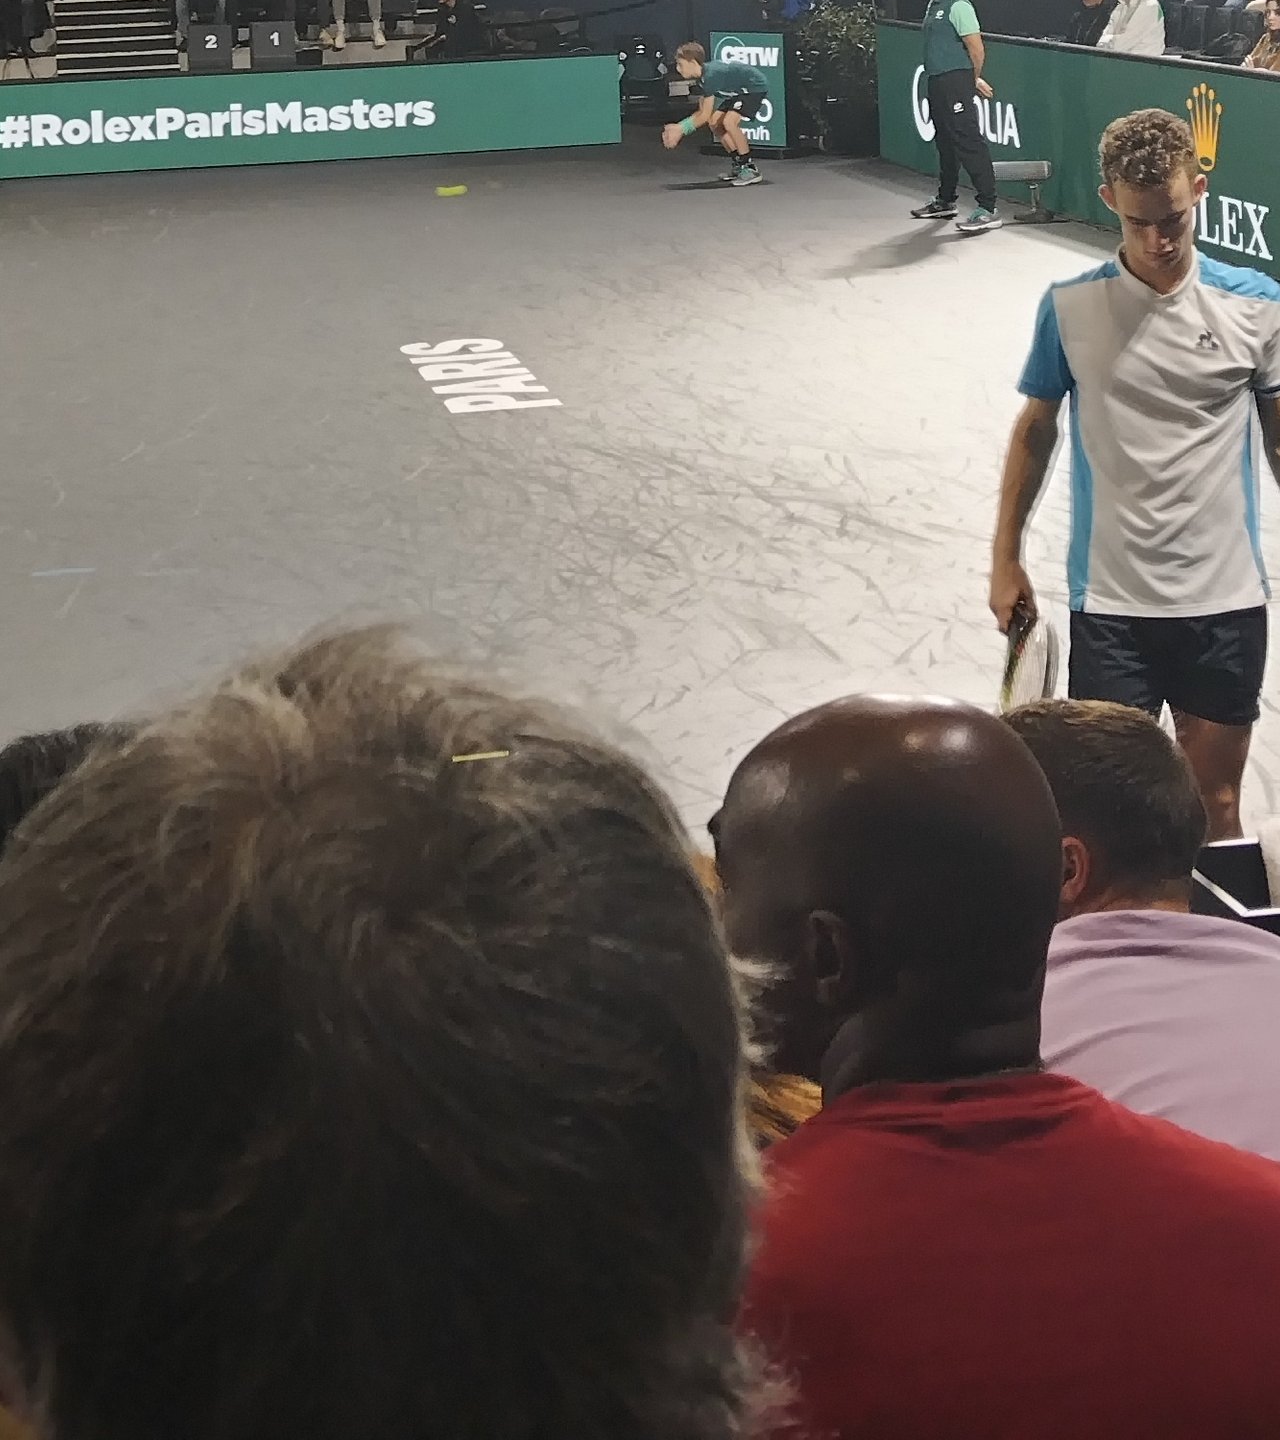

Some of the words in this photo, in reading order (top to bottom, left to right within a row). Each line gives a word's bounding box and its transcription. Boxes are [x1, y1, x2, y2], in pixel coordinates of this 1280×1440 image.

[204, 34, 218, 49] 2
[269, 31, 280, 46] 1
[740, 125, 771, 141] m/h
[1192, 191, 1274, 261] LEX
[399, 337, 564, 414] PARIS
